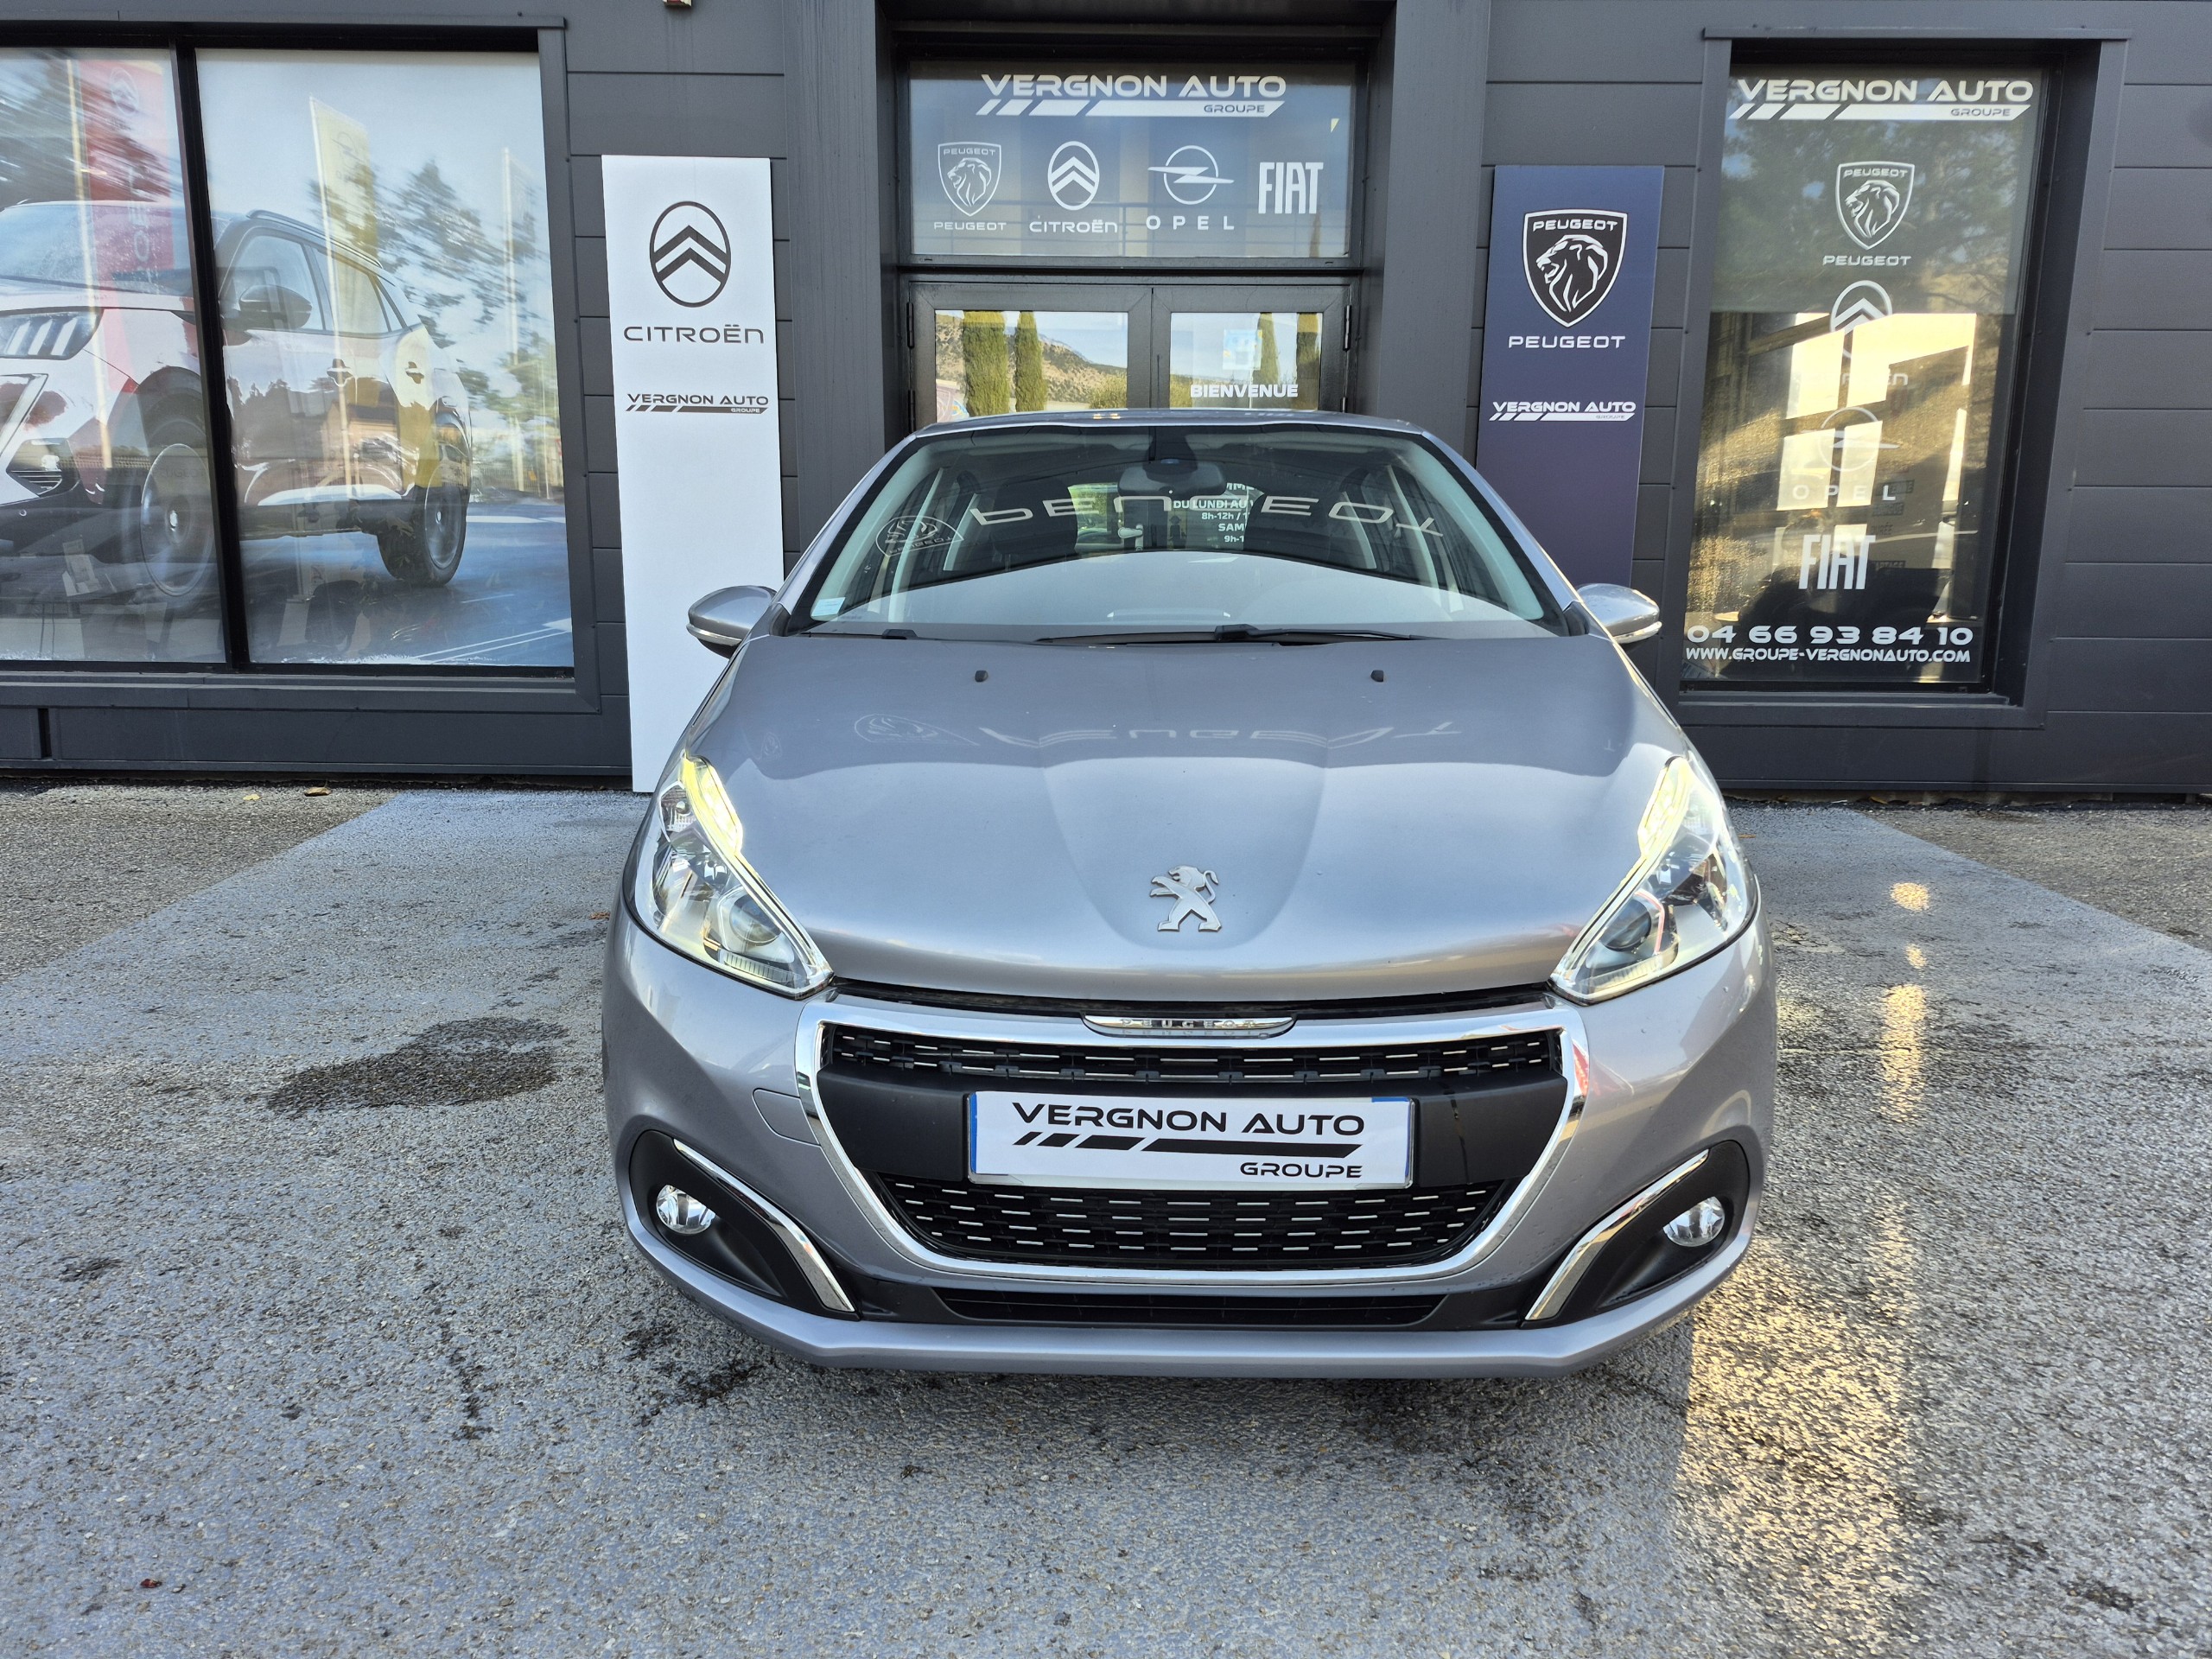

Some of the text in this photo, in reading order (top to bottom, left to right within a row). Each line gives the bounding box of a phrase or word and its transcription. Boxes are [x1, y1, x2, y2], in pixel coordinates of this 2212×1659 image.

[982, 74, 1287, 98] VERGNON AUTO
[1737, 79, 2034, 102] VERGNON AUTO
[1204, 105, 1265, 113] GROUPE
[1950, 108, 2011, 117] GROUPE
[1843, 168, 1908, 178] PEUGEOT
[1258, 162, 1324, 213] FIAT
[934, 222, 1007, 231] PEUGEOT
[1146, 215, 1235, 230] OPEL
[1533, 219, 1618, 232] PEUGEOT
[1822, 255, 1911, 266] PEUGEOT
[1509, 336, 1625, 348] PEUGEOT
[1191, 385, 1299, 398] BIENVENUE
[627, 394, 768, 405] VERGNON AUTO
[1493, 402, 1636, 412] VERGNON AUTO
[1792, 485, 1896, 500] OPEL
[1173, 500, 1190, 509] DU
[1192, 500, 1228, 509] LUNDI
[1230, 500, 1247, 509] AU
[1201, 512, 1234, 520] 8h-12h
[1798, 535, 1876, 589] FIAT
[1687, 625, 1974, 645] 04 66 93 84 10
[1686, 647, 1971, 663] WWW.GROUPE-VERGNONAUTO.COM
[1122, 1019, 1256, 1029] PEUGEOT
[1012, 1102, 1365, 1136] VERGNON AUTO
[1239, 1162, 1363, 1179] GROUPE
